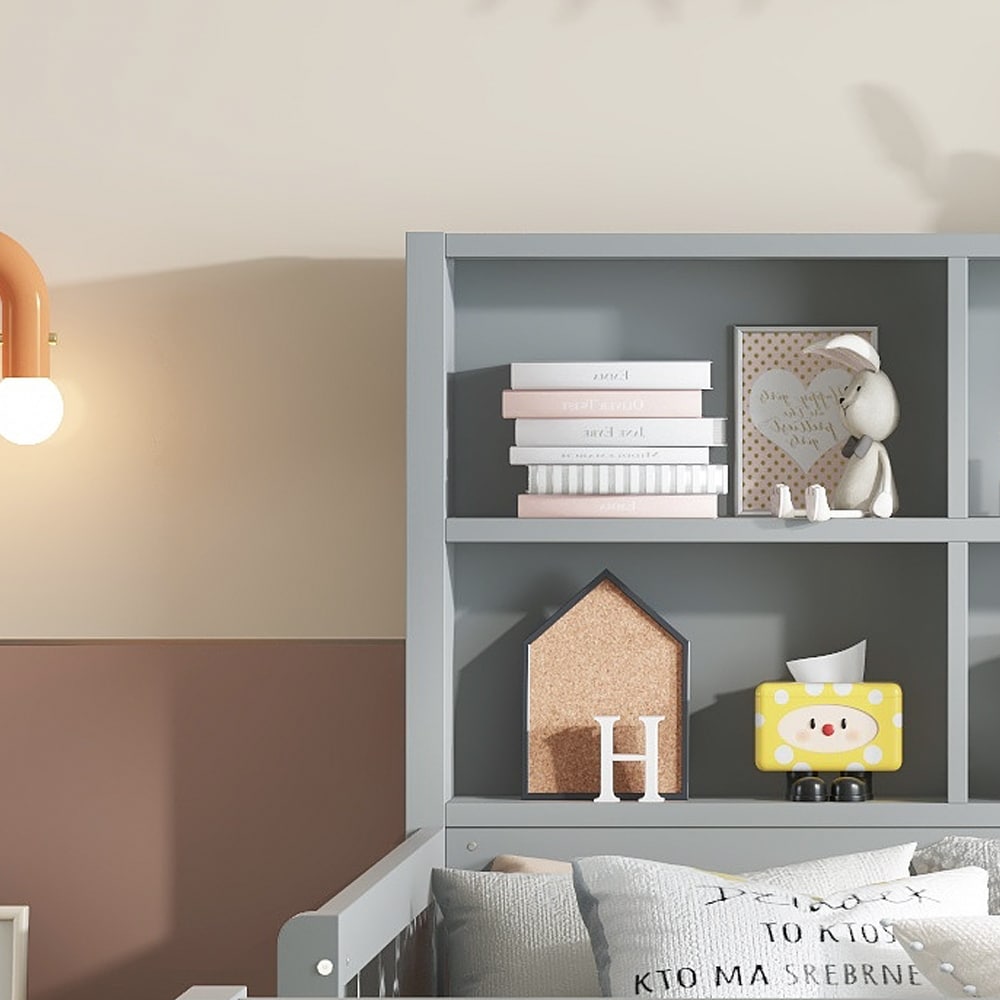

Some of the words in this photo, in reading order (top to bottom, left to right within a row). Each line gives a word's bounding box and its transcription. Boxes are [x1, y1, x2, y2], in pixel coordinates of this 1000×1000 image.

[593, 715, 666, 803] H
[761, 922, 802, 943] TO
[634, 966, 697, 995] KTO
[715, 964, 770, 987] MA
[785, 963, 924, 986] SREBRNE
